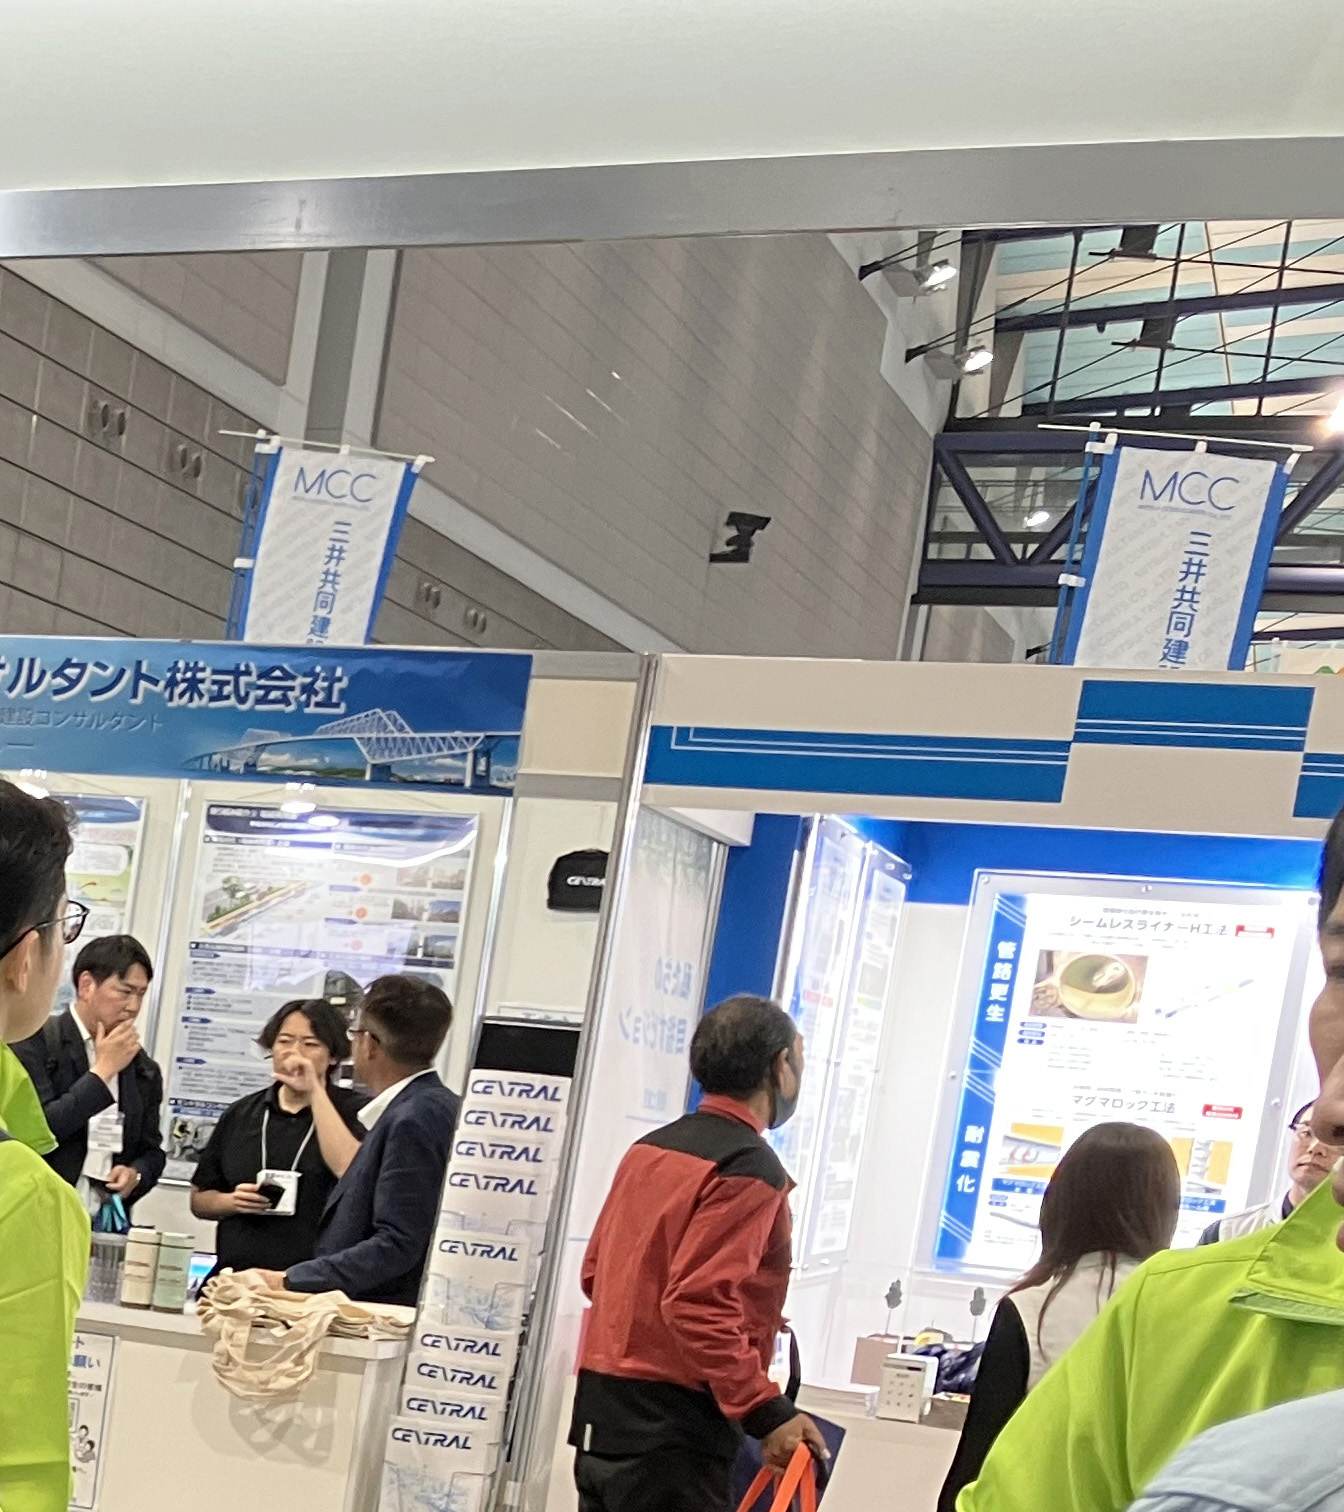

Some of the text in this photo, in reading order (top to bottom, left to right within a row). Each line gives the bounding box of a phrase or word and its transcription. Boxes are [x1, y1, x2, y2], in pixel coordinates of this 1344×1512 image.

[294, 467, 377, 502] MCC
[1140, 469, 1240, 511] MCC
[306, 521, 352, 645] 三井共同建
[1159, 531, 1212, 669] 三井共同建
[984, 940, 1018, 1023] 管路更生
[471, 1079, 563, 1102] CENTRAL
[464, 1110, 555, 1133] CENTRAL
[455, 1140, 544, 1163] CENTRAL
[956, 1125, 984, 1194] 耐震化
[449, 1172, 538, 1196] CENTRAL
[438, 1239, 518, 1262] CENTRAL
[420, 1333, 502, 1357] CENTRAL
[417, 1363, 498, 1390] CENTRAL
[406, 1397, 488, 1421] CENTRAL
[392, 1427, 472, 1451] CENTRAL
